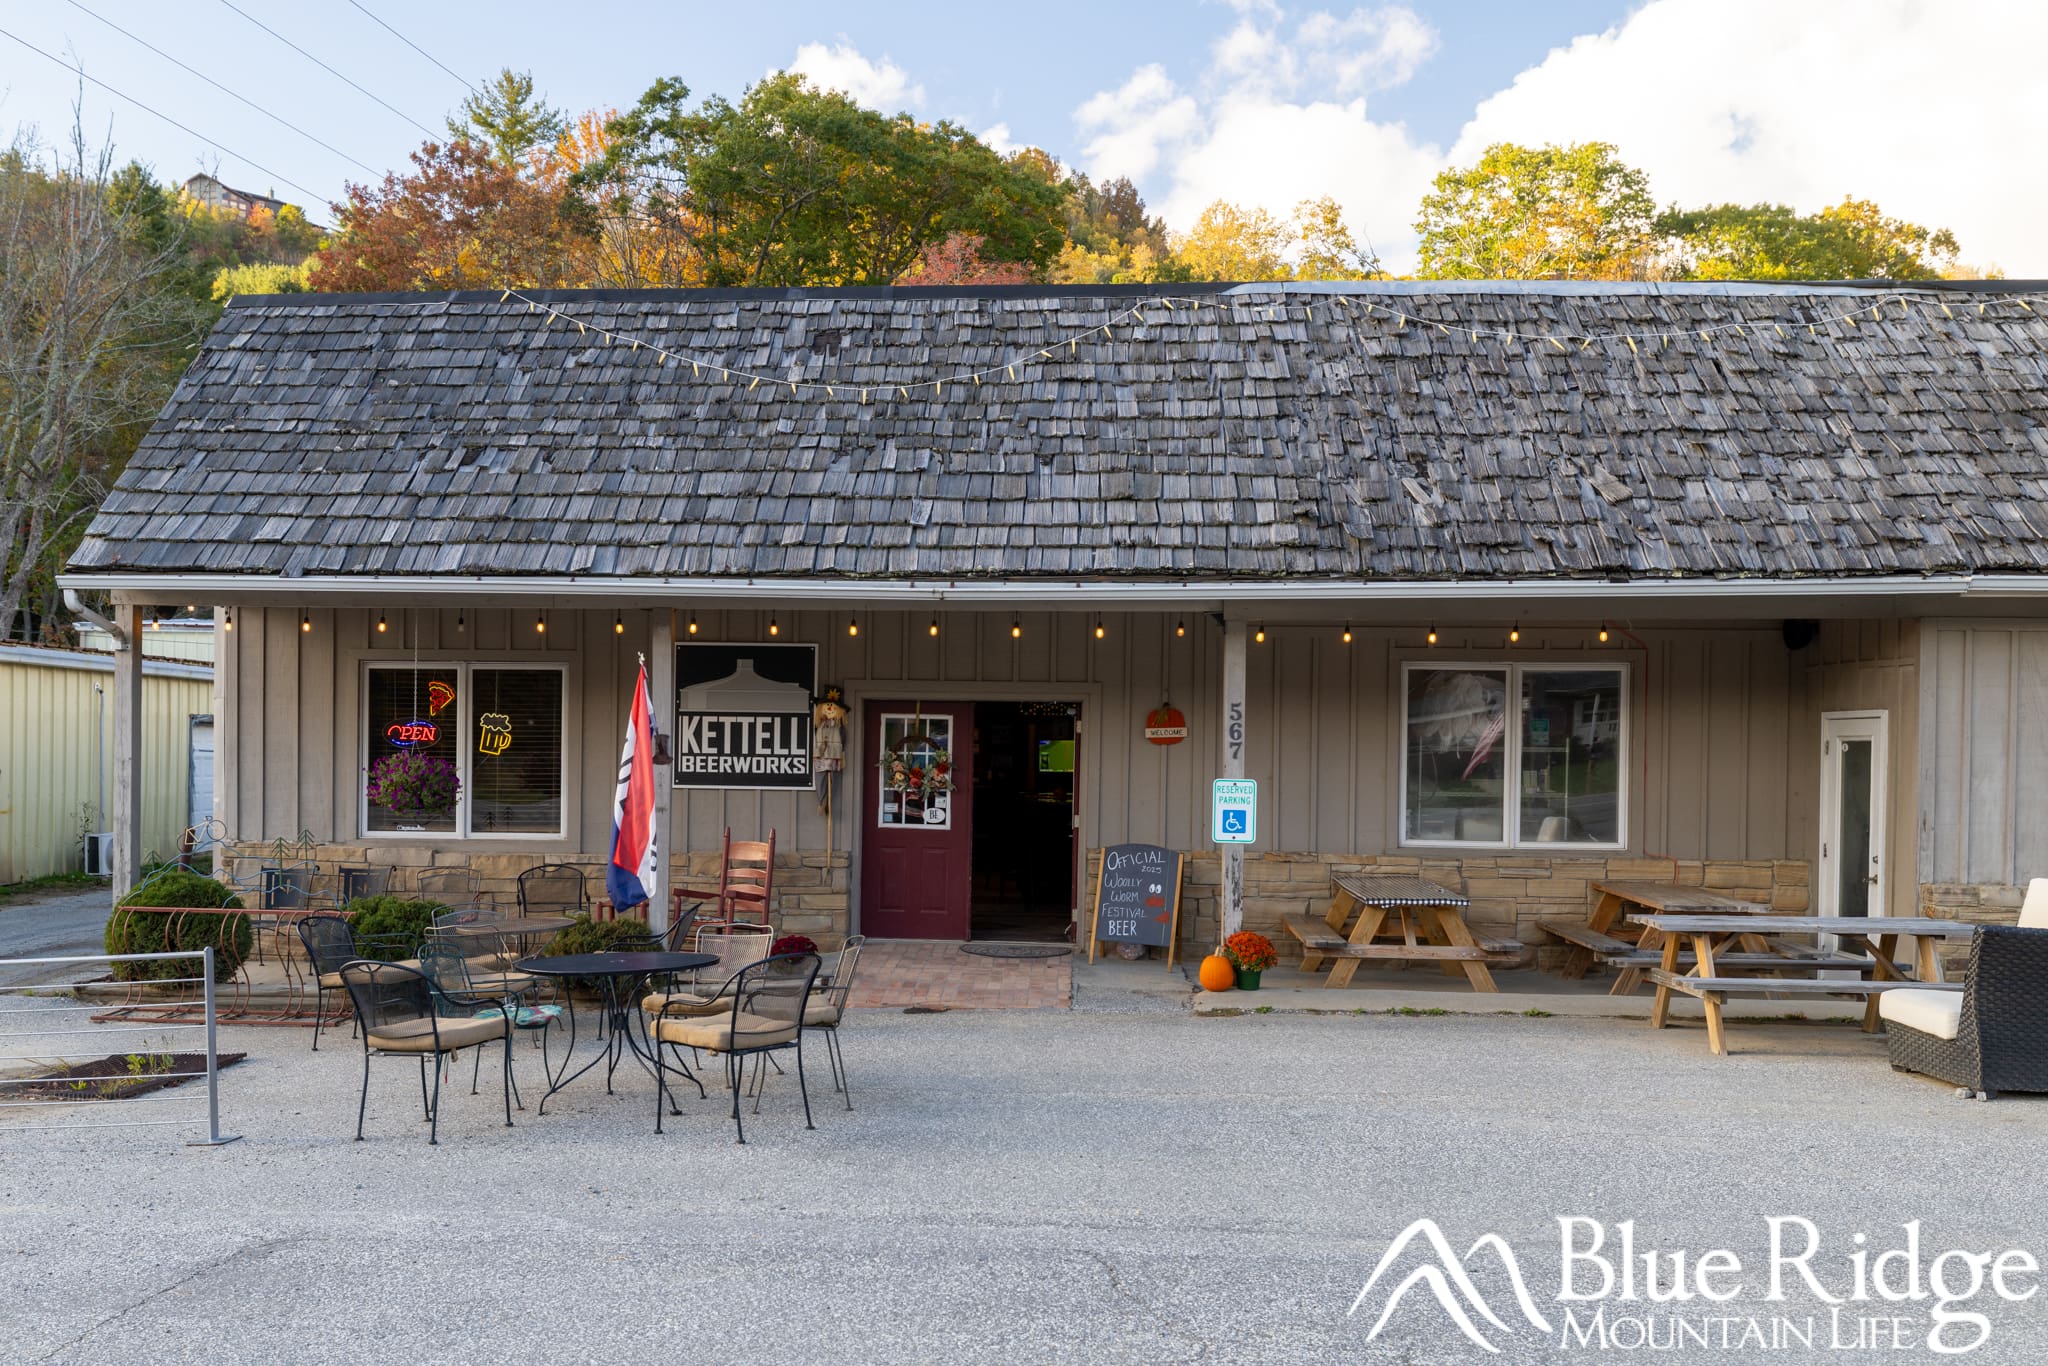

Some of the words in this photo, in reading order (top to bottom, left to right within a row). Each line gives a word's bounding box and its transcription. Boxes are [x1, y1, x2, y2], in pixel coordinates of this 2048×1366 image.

[387, 725, 437, 741] OPEN
[682, 715, 806, 755] KETTELL
[1229, 702, 1242, 760] 567
[681, 755, 806, 774] BEERWORKS
[1216, 785, 1253, 795] RESERVED
[1218, 796, 1251, 805] PARKING
[1108, 920, 1137, 936] BEER
